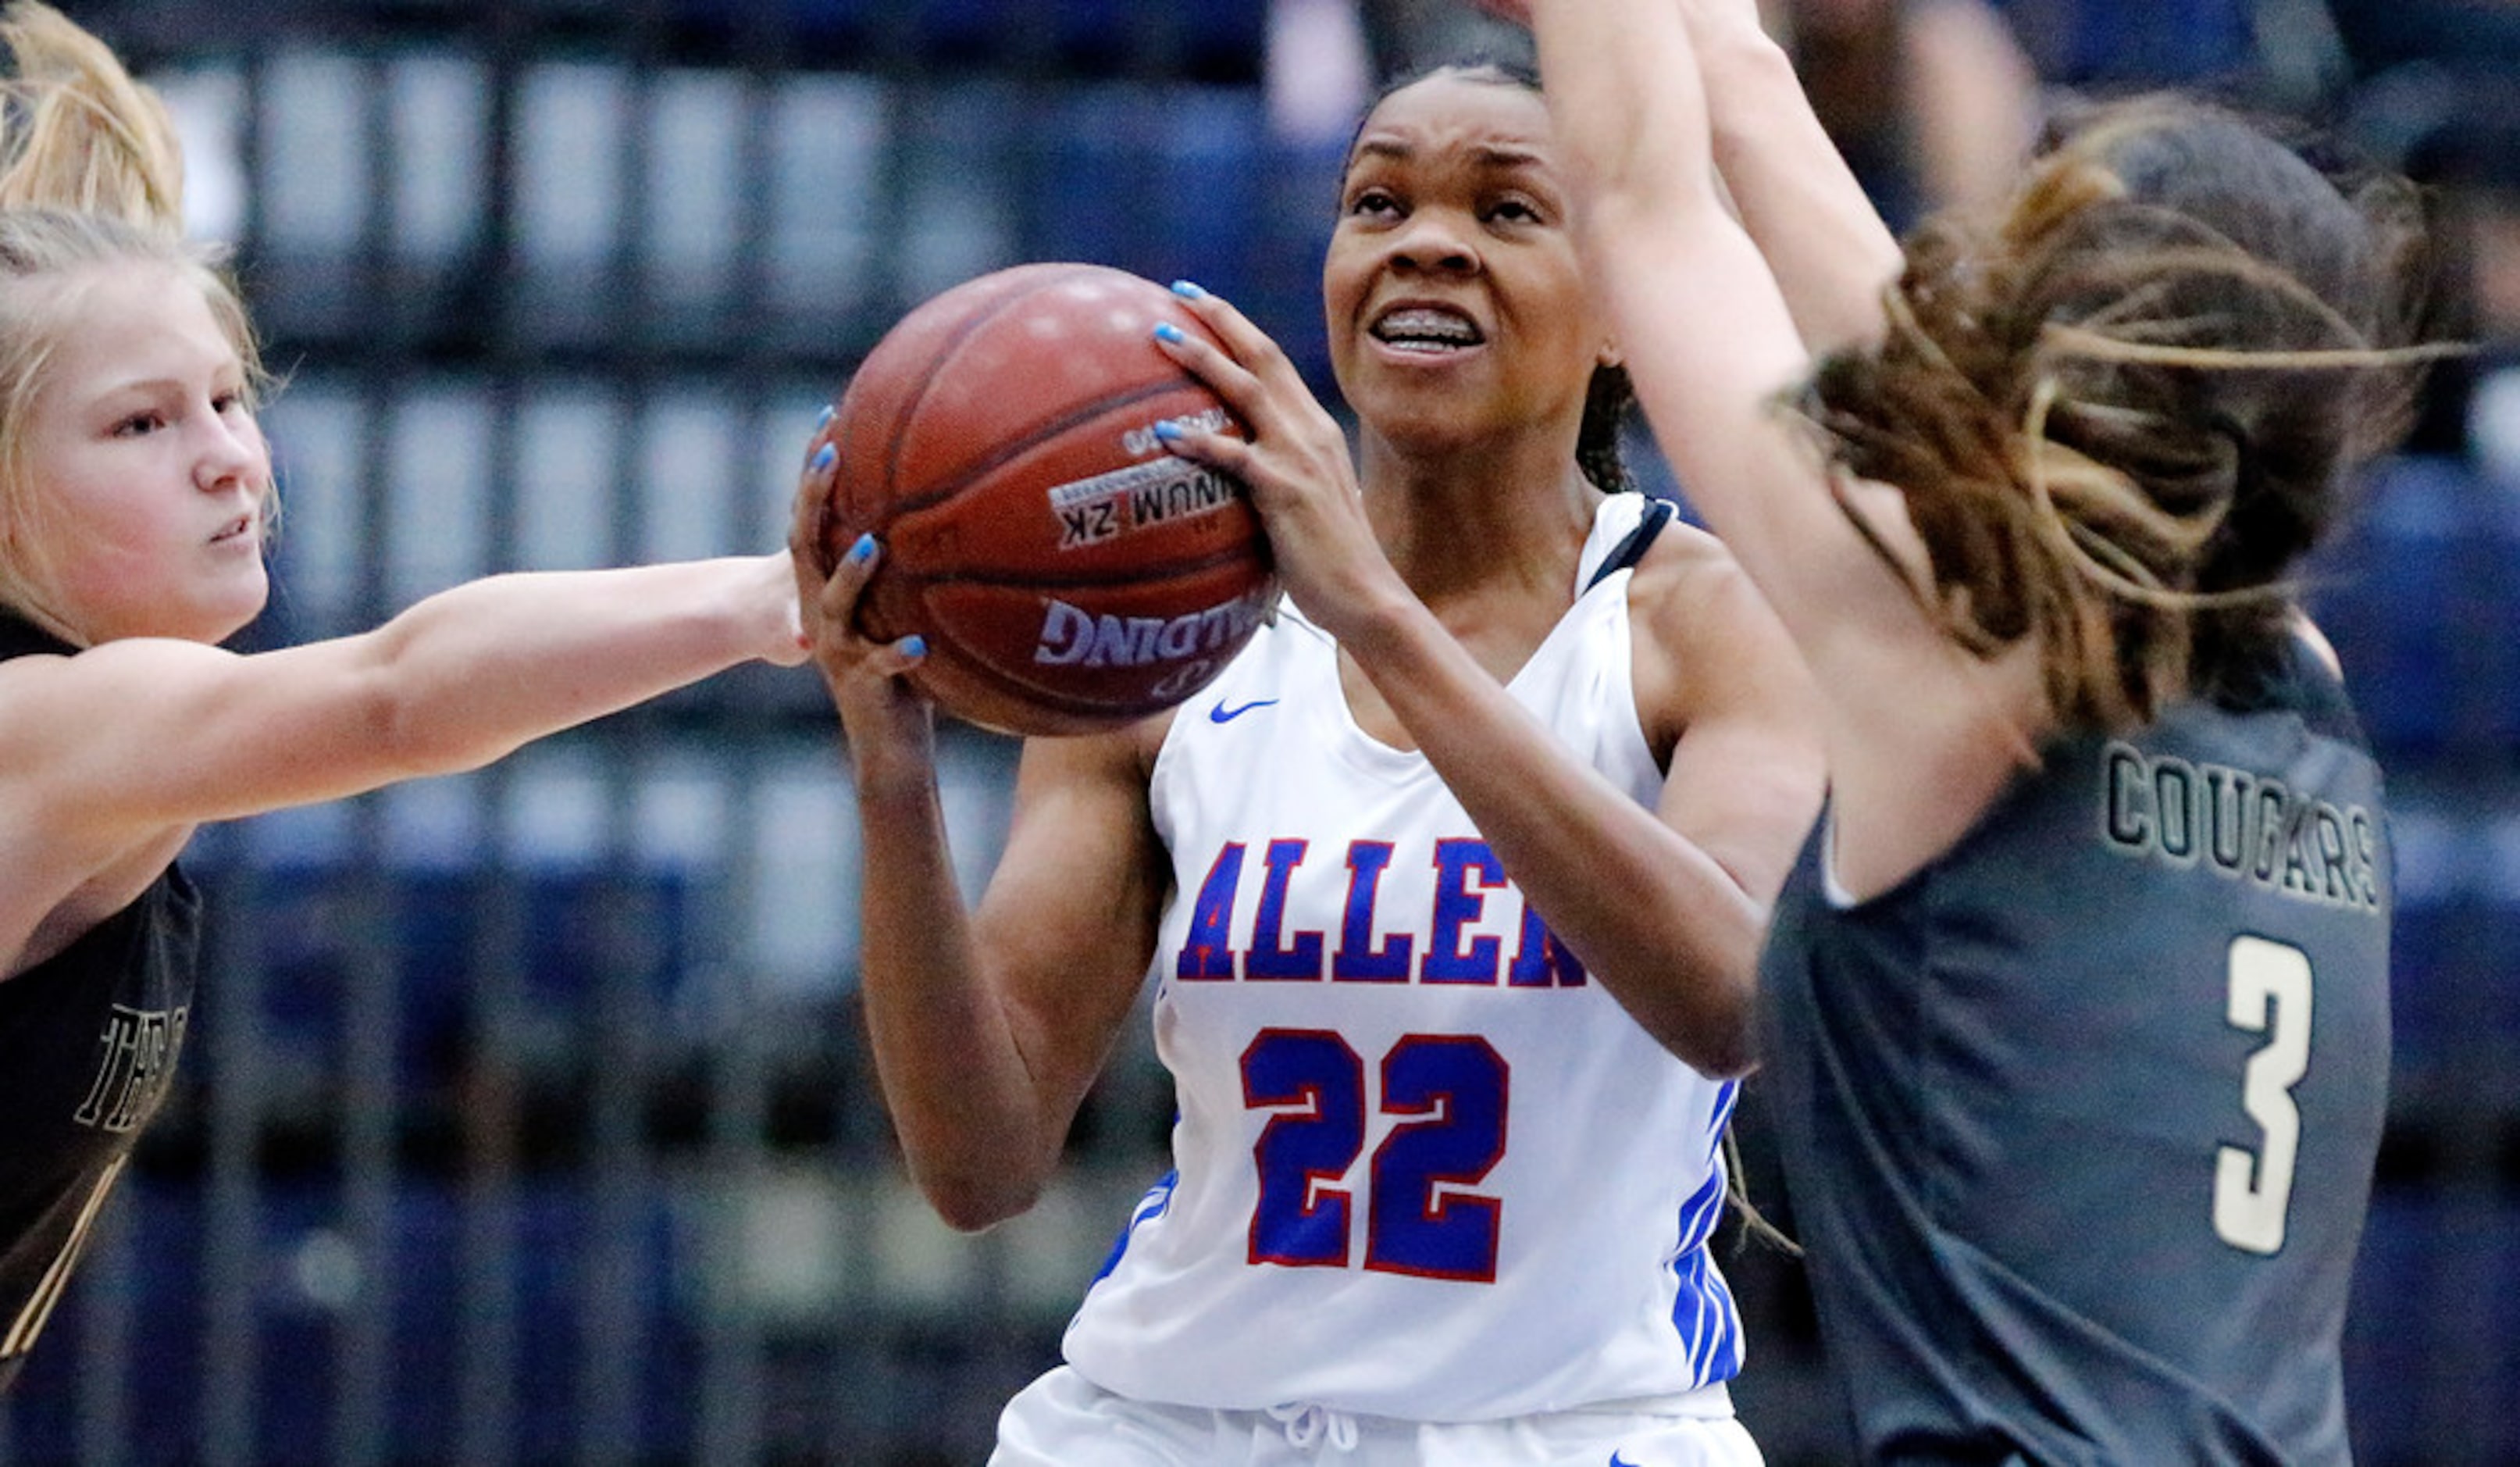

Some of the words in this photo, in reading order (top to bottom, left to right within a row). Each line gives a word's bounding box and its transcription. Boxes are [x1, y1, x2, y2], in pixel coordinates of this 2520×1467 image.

[2104, 740, 2378, 913] COUGARS
[1239, 1027, 1510, 1284] 22
[2212, 934, 2313, 1255] 3
